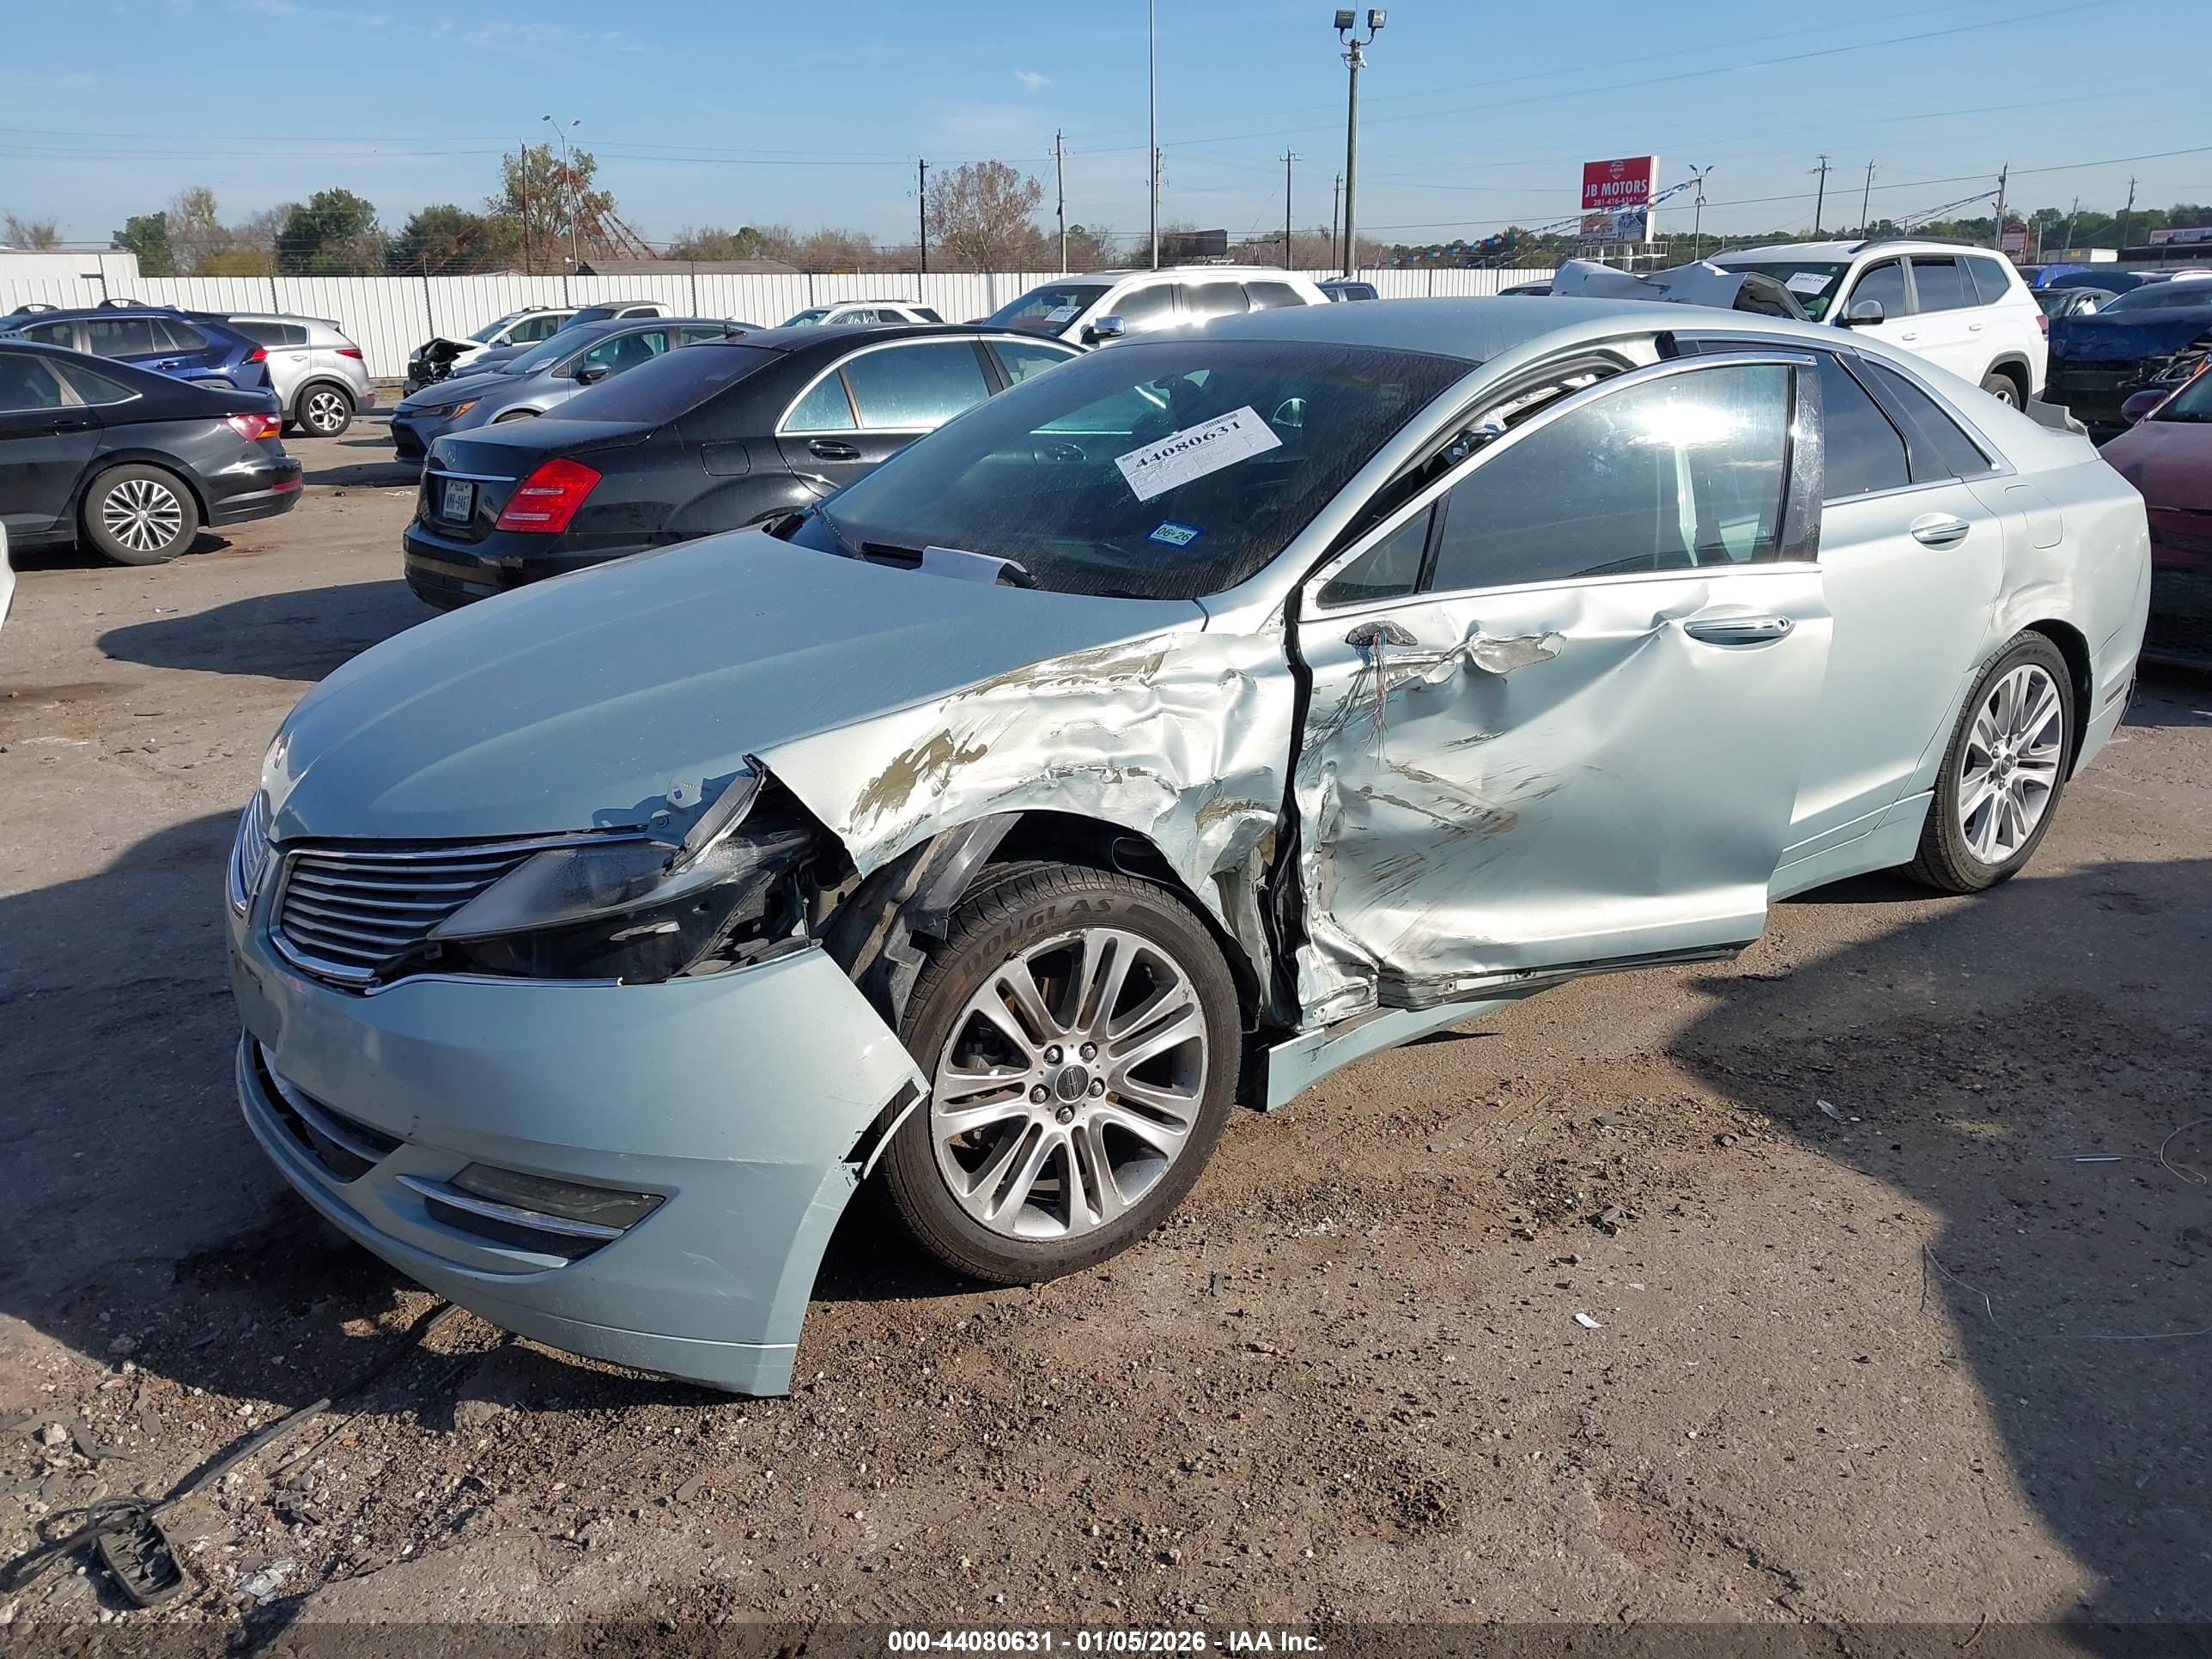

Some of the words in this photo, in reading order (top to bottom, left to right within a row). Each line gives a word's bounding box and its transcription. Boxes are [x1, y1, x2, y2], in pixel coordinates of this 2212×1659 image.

[1585, 184, 1598, 198] JB
[1601, 179, 1647, 197] MOTORS
[1136, 421, 1242, 468] 44080631
[962, 898, 1115, 980] DOUGLAS
